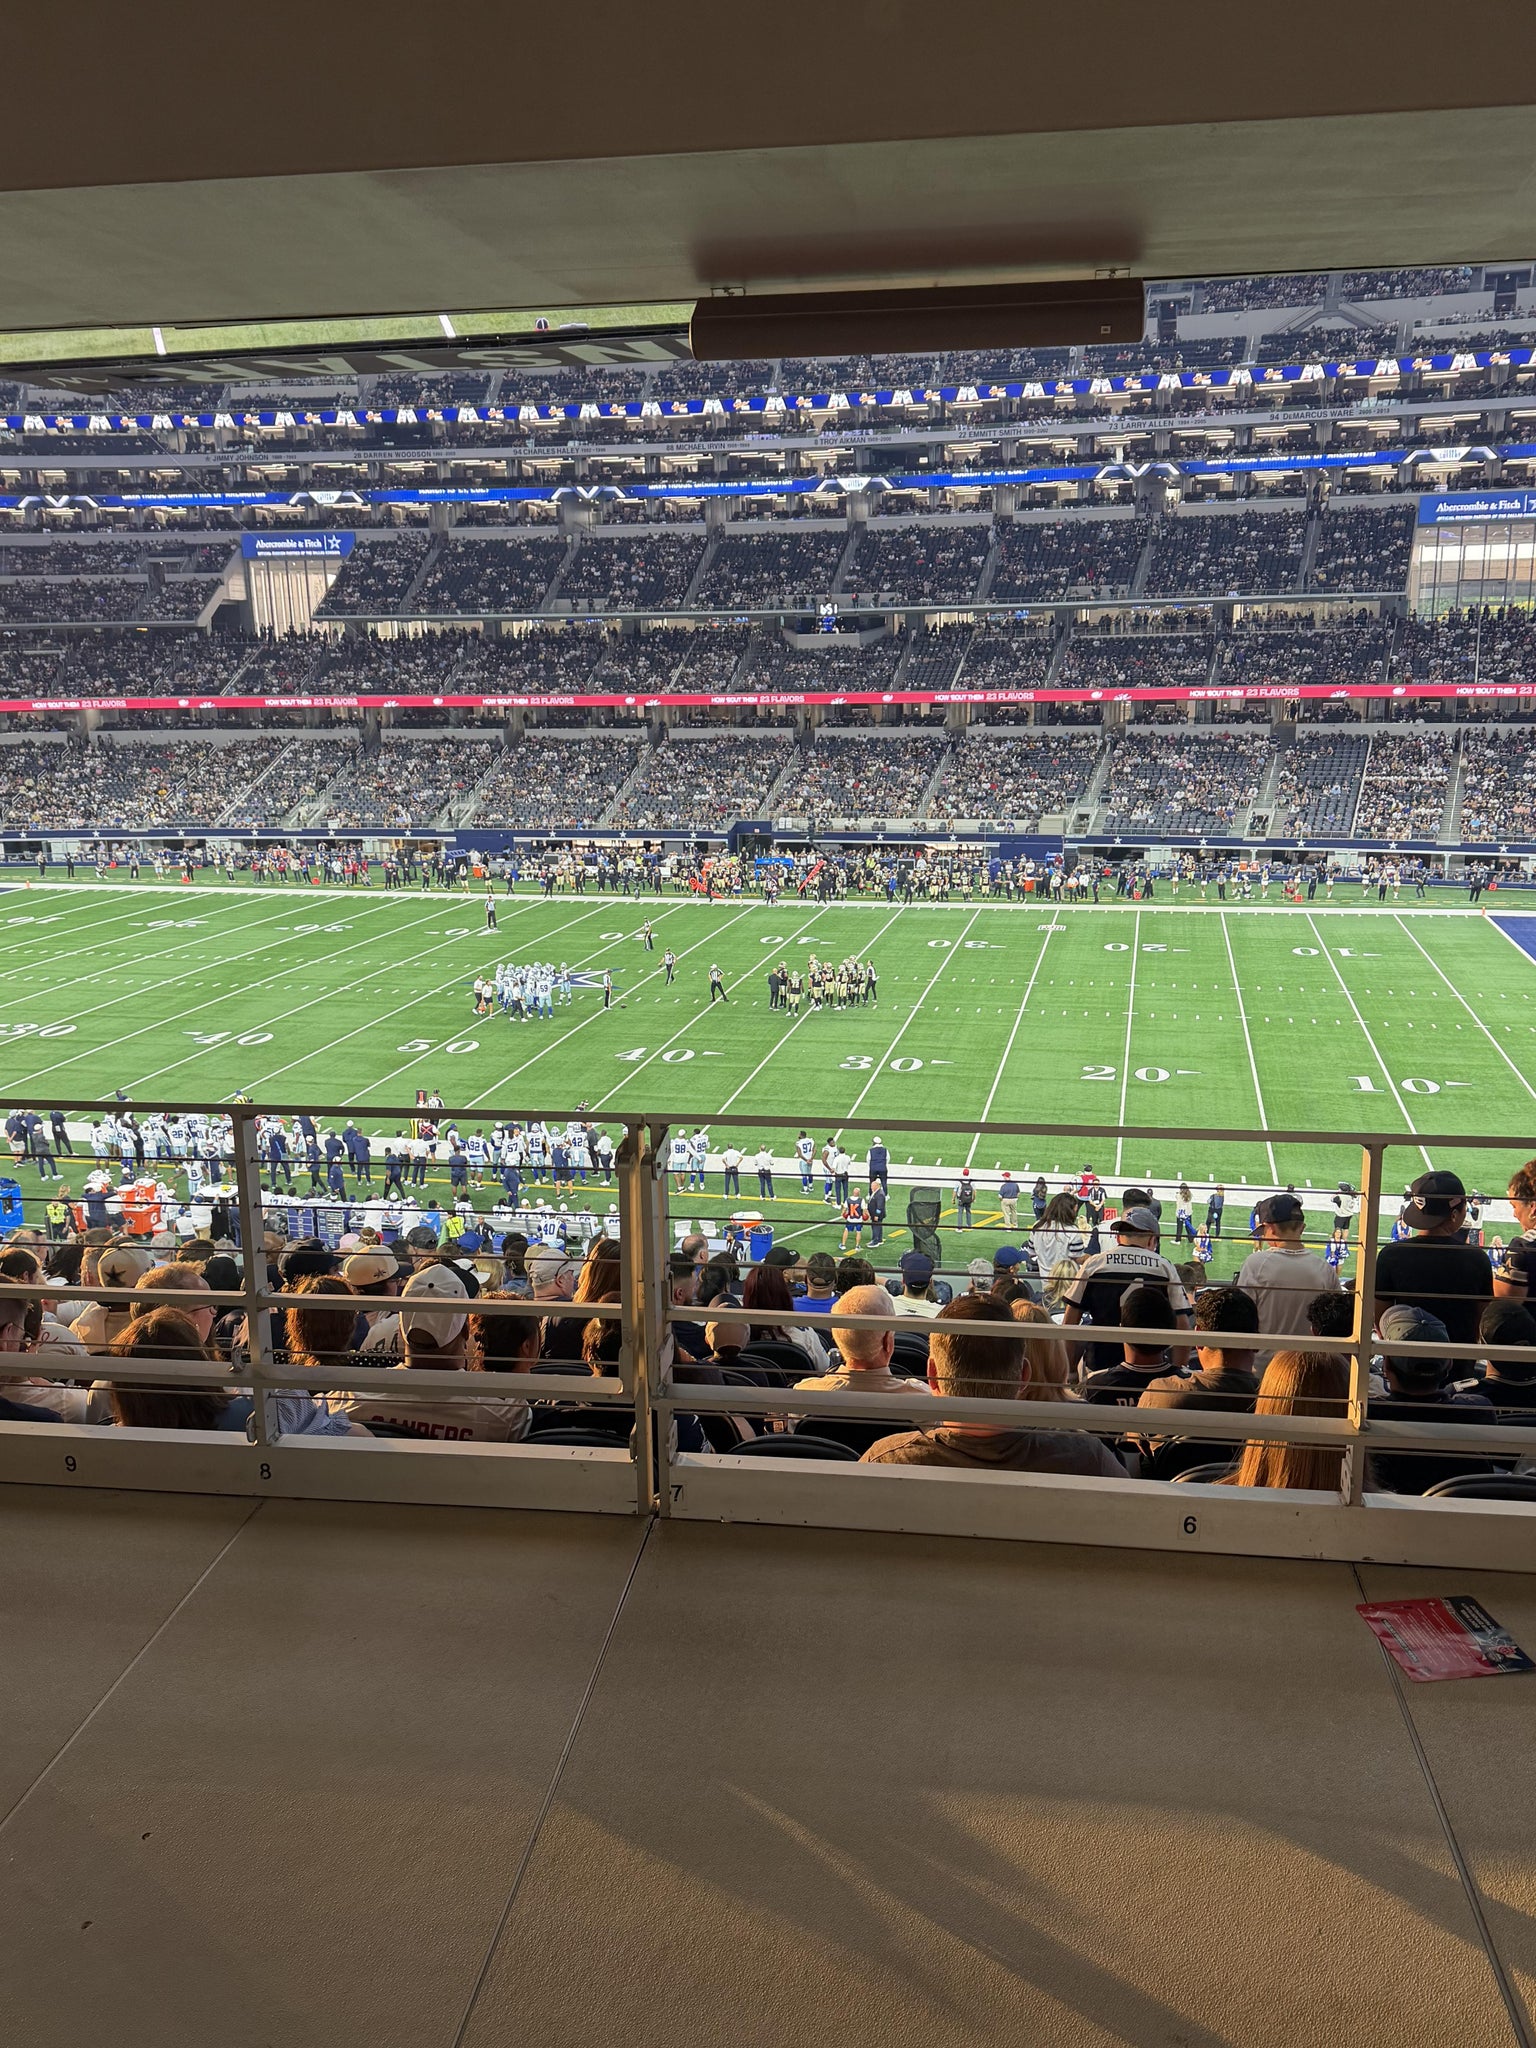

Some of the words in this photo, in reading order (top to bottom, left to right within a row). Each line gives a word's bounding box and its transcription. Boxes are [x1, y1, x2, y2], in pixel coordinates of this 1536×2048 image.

[1330, 409, 1354, 417] WARE
[1121, 422, 1147, 430] LARRY
[1436, 501, 1489, 512] Abercrombie
[1498, 500, 1520, 510] Fitch
[256, 539, 297, 548] Abercrombie
[304, 539, 322, 548] Fitch
[998, 692, 1034, 700] FLAVORS
[82, 700, 91, 708] 23
[93, 700, 126, 708] FLAVORS
[194, 1031, 274, 1046] 40
[397, 1038, 480, 1054] 50
[614, 1048, 696, 1062] 40
[838, 1055, 924, 1072] 30
[1080, 1065, 1171, 1082] 20
[1347, 1076, 1441, 1095] 10
[172, 1130, 184, 1139] 26
[470, 1141, 480, 1151] 92
[507, 1142, 518, 1152] 57
[530, 1138, 540, 1148] 45
[571, 1138, 583, 1147] 42
[803, 1142, 812, 1153] 97
[675, 1144, 686, 1153] 98
[850, 1204, 860, 1217] K
[1105, 1209, 1117, 1220] 20
[150, 1212, 157, 1224] G
[543, 1224, 556, 1235] 40
[1106, 1253, 1160, 1268] PRESCOTT
[65, 1456, 77, 1472] 9
[260, 1463, 272, 1479] 8
[671, 1485, 683, 1501] 7
[1183, 1516, 1197, 1534] 6
